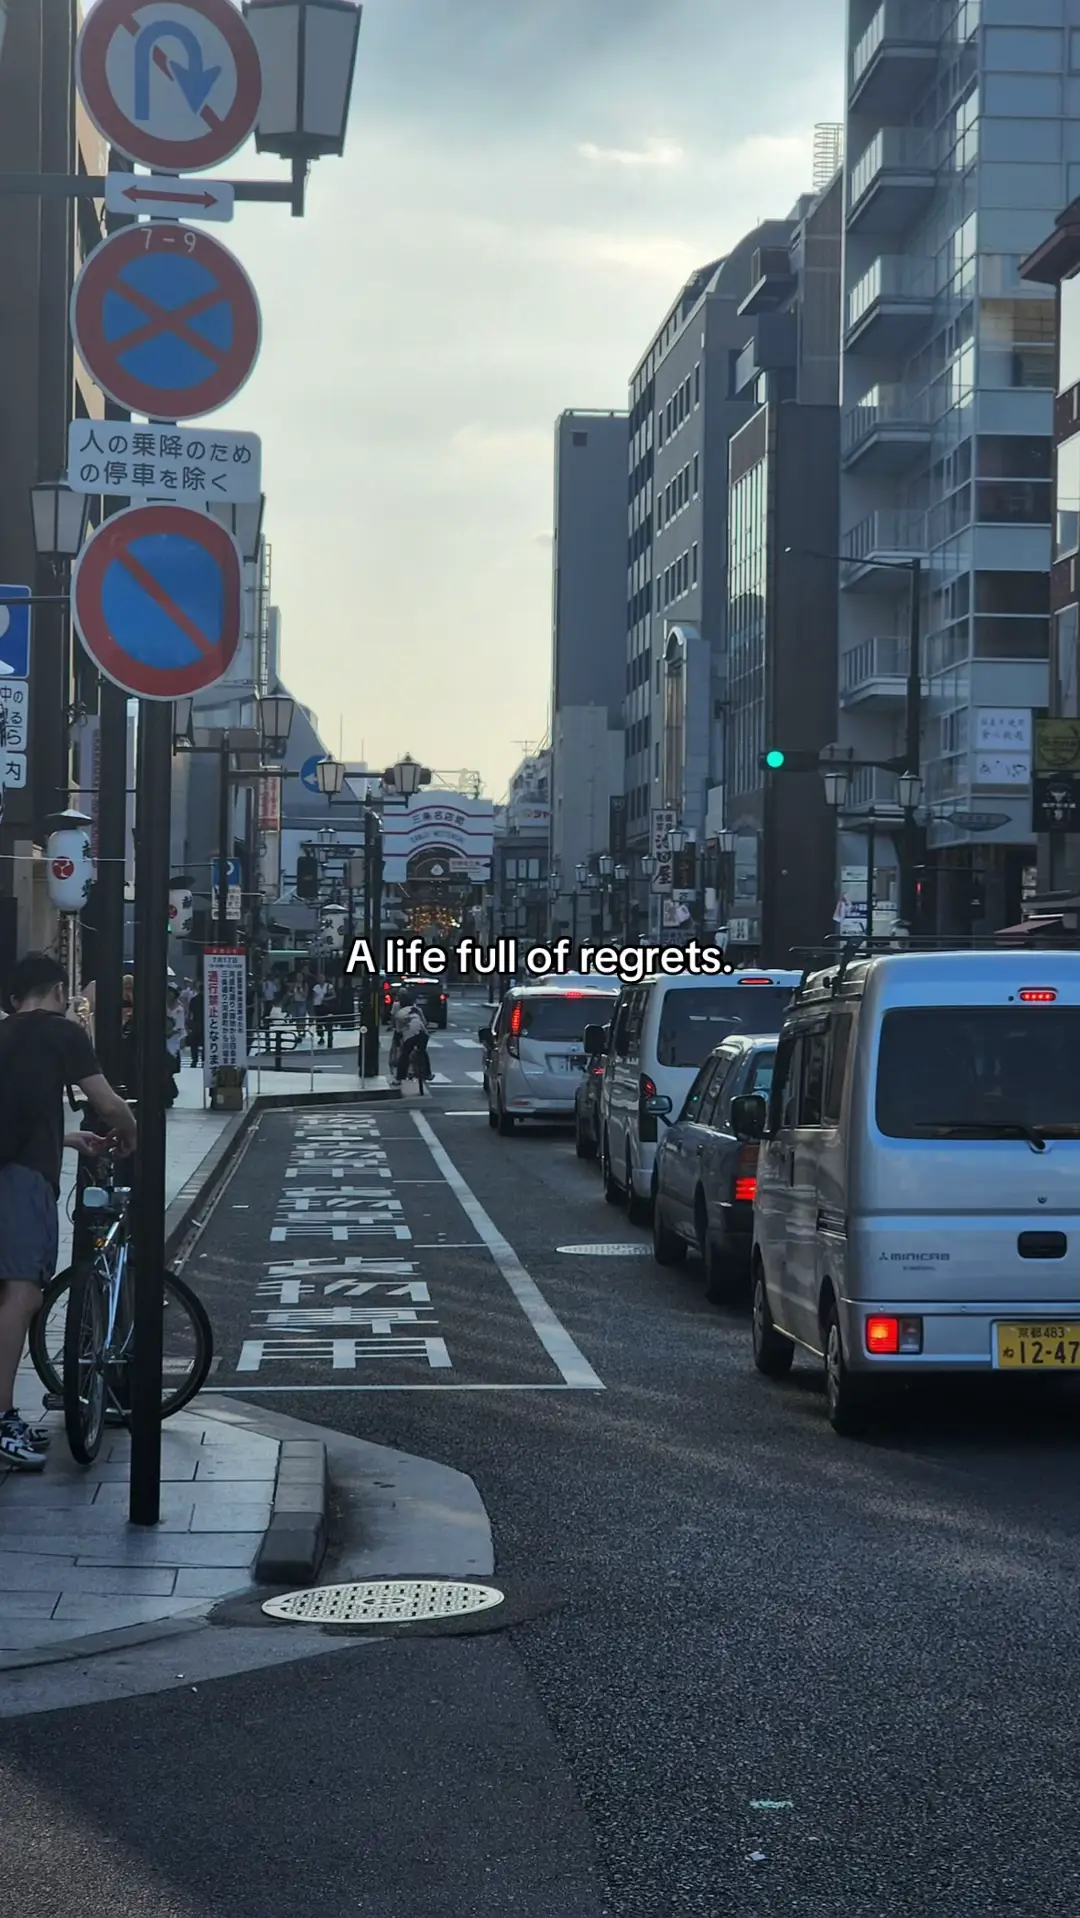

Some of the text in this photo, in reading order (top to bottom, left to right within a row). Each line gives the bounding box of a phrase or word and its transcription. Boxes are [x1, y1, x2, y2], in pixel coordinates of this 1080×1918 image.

[79, 429, 252, 465] 人の乗降のため
[79, 460, 228, 492] の停車を除く
[1020, 1342, 1080, 1364] 12-47
